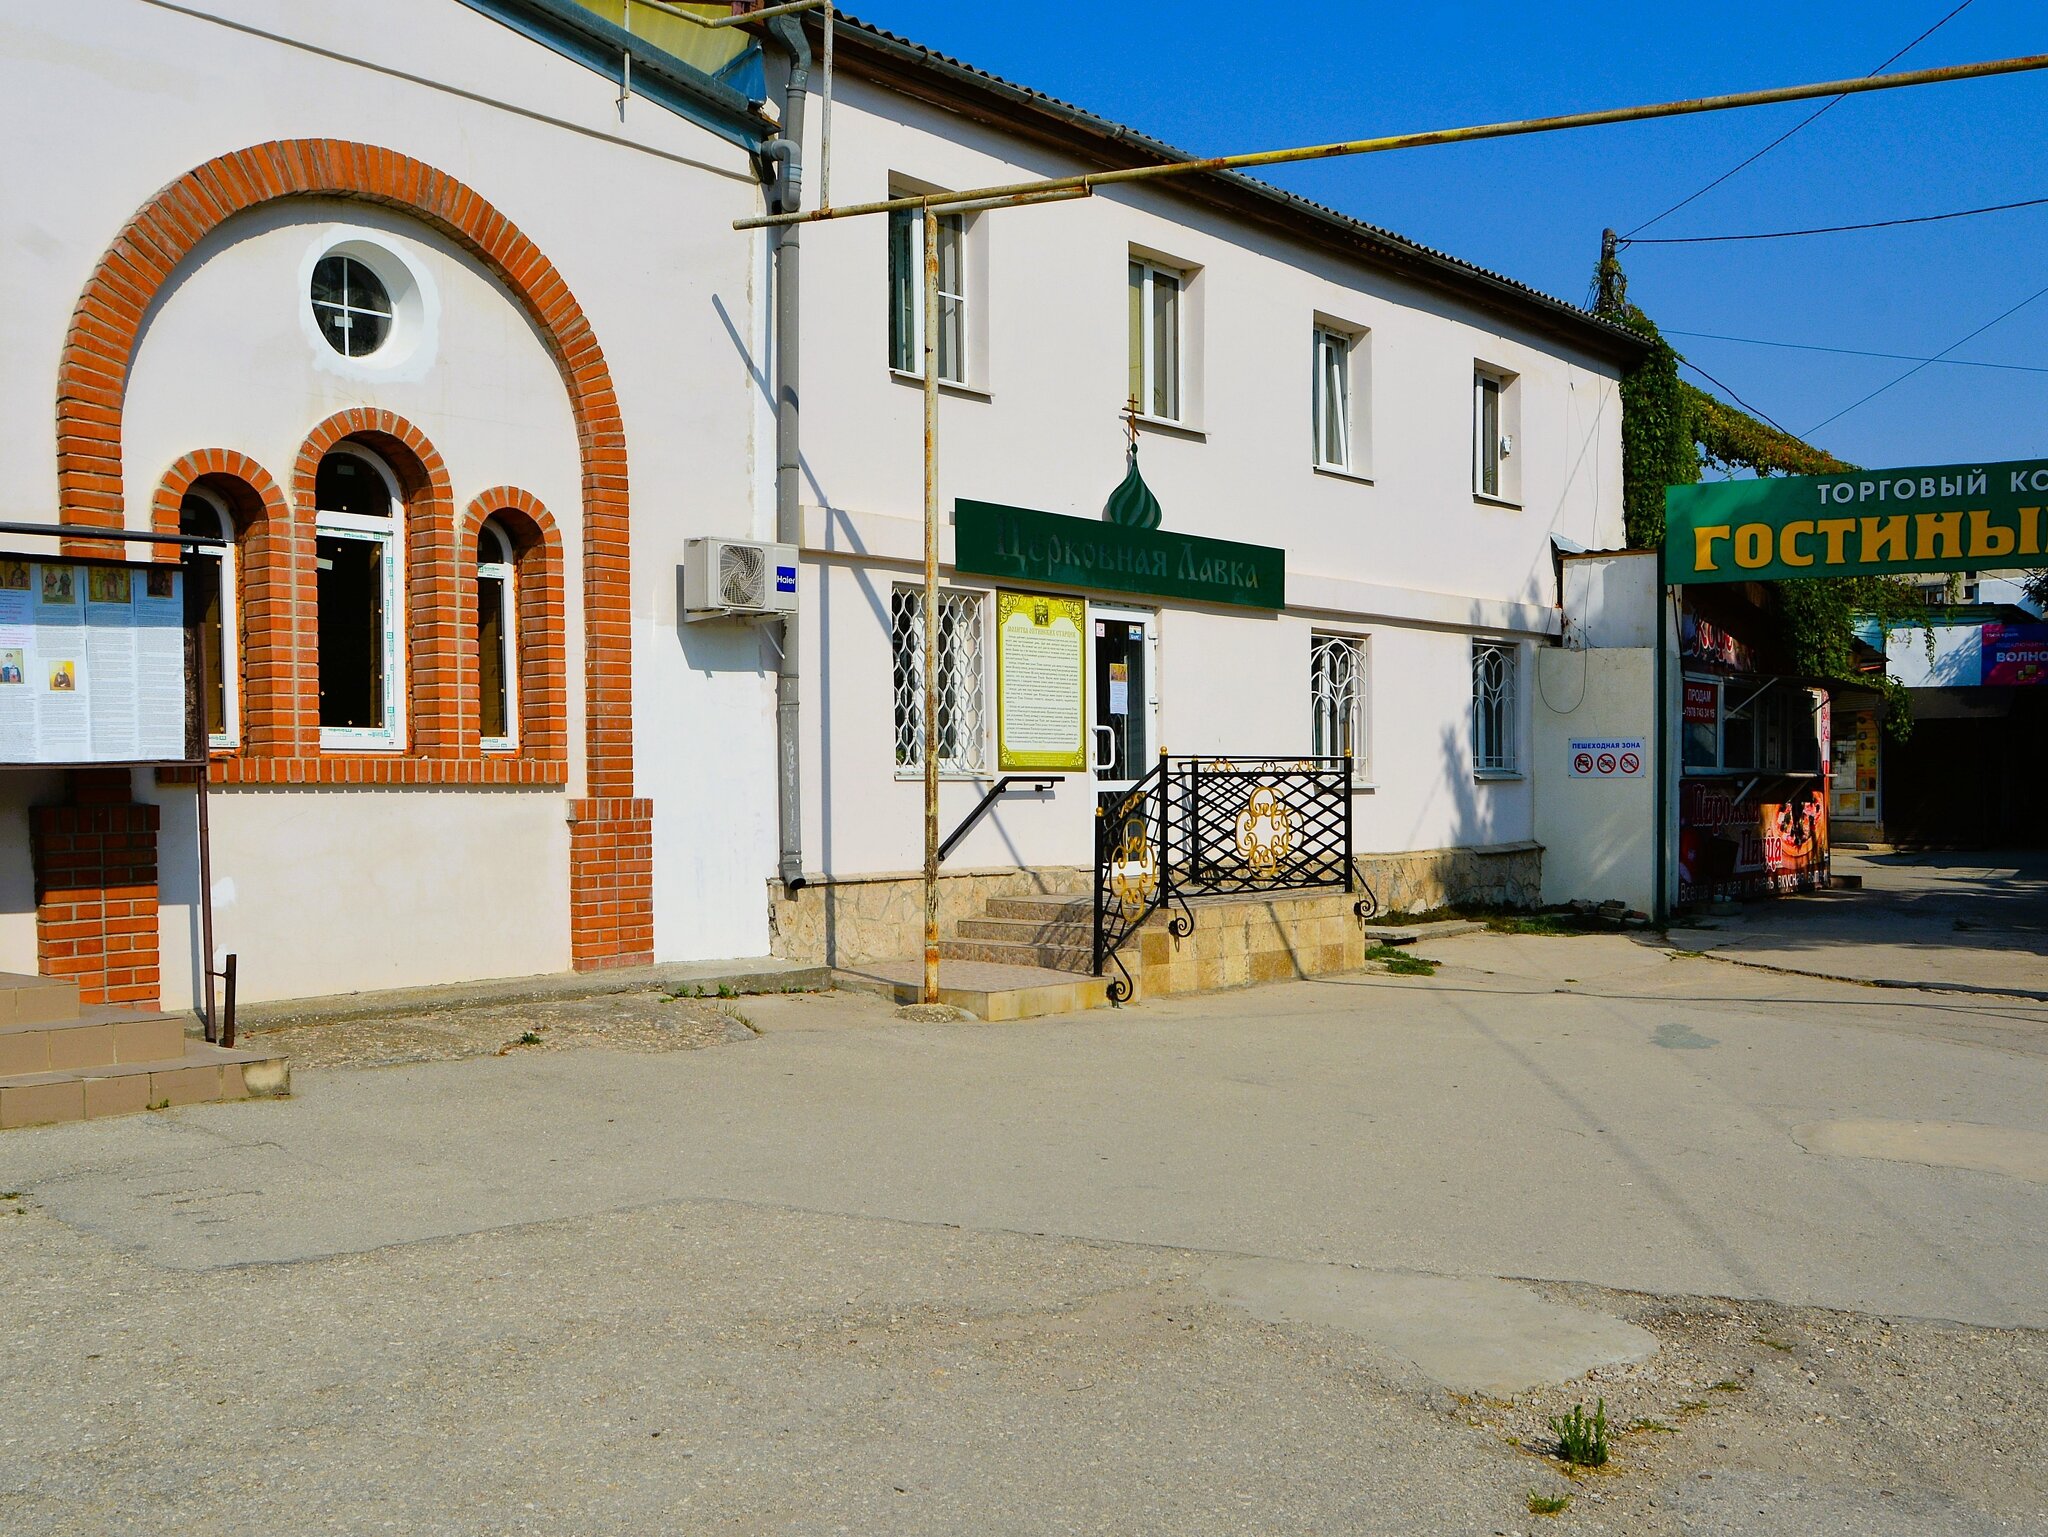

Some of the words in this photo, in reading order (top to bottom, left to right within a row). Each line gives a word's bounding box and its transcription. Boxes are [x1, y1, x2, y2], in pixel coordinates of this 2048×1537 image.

[1818, 469, 1987, 505] ТОРГОВЫЙ
[994, 513, 1168, 577] Церковная
[1178, 542, 1260, 588] Лавка
[1693, 506, 2048, 571] ГОСТИНЫ
[777, 575, 795, 584] Haier
[1687, 688, 1711, 704] ПРОДАМ
[1572, 742, 1620, 750] ПЕШЕХОДНАЯ
[1740, 828, 1782, 872] Пицца
